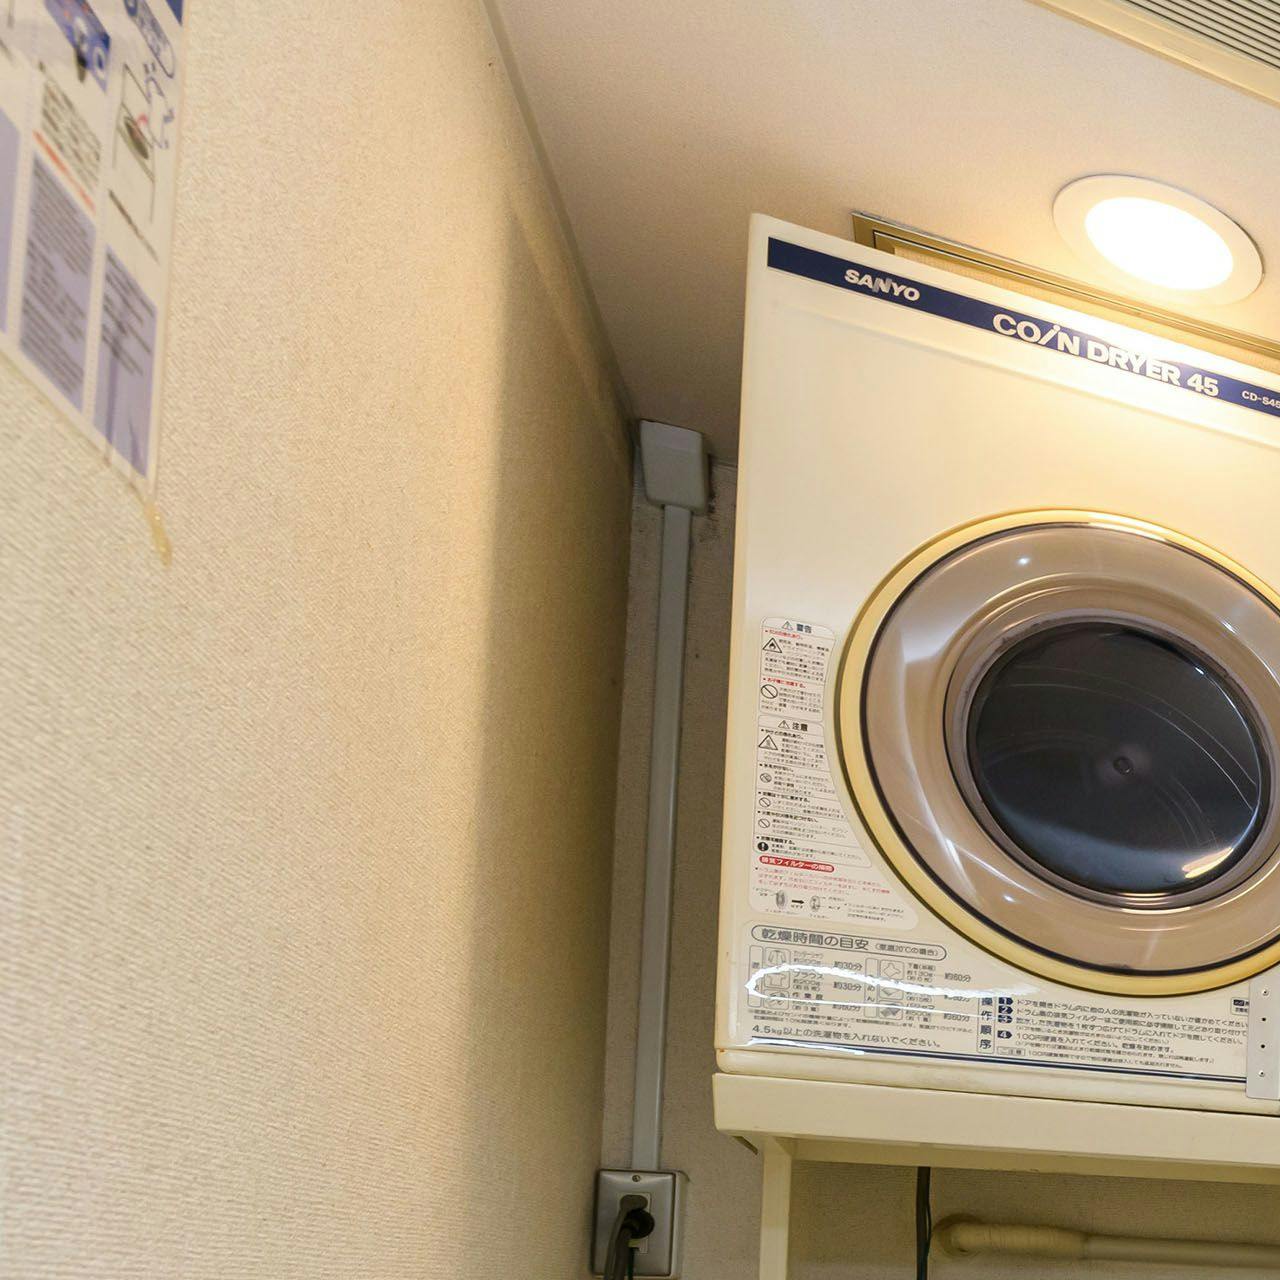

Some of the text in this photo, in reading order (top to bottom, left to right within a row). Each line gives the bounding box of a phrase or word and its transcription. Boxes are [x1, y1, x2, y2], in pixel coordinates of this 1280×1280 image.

[844, 269, 921, 301] SANYO
[1087, 339, 1182, 387] DRYER
[1187, 374, 1219, 397] 45
[792, 722, 808, 732] 注意
[762, 928, 869, 950] 乾燥時間の目安
[752, 1025, 942, 1048] 4.5kg以上の洗濯物を入れないでください。
